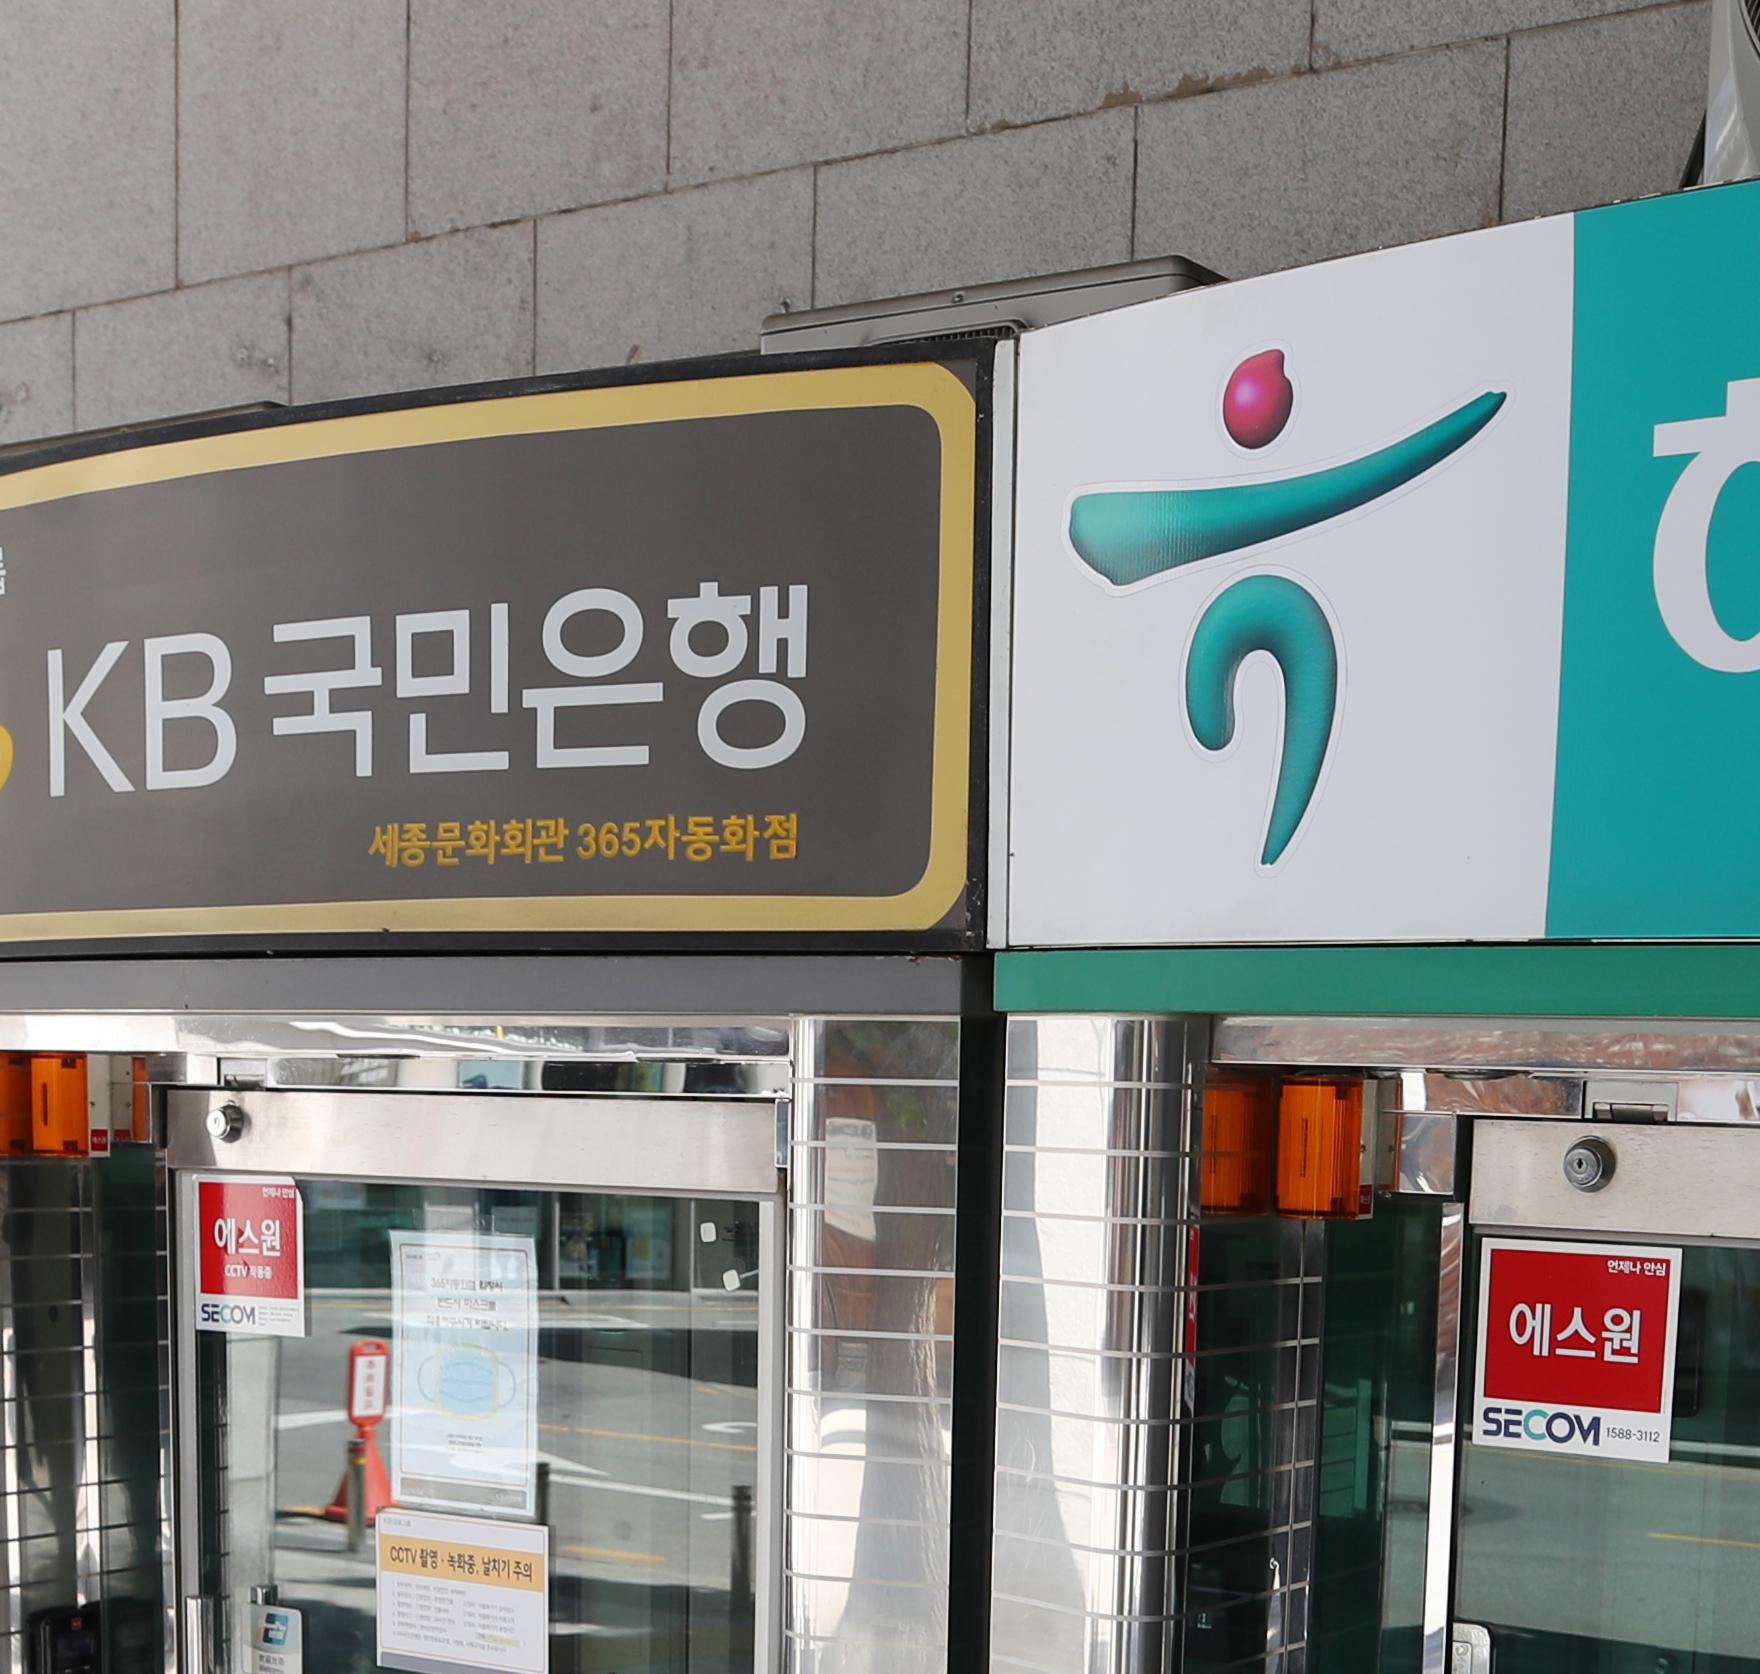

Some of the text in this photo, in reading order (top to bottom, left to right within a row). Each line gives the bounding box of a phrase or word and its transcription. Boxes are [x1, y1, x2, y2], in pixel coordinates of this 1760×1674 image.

[45, 580, 809, 799] KB국민은행
[367, 812, 799, 868] 세종문화회관 365자동화점
[213, 1217, 283, 1258] 에스원
[224, 1263, 250, 1279] CCTV
[1607, 1259, 1667, 1277] 언제나 안심
[201, 1303, 257, 1327] SECOM
[1508, 1302, 1642, 1365] 에스원
[1482, 1406, 1661, 1447] SECOM 1588-3112
[390, 1545, 418, 1565] CCTV
[418, 1547, 439, 1570] 촬영
[481, 1556, 511, 1580] 날치기
[512, 1560, 534, 1583] 주의
